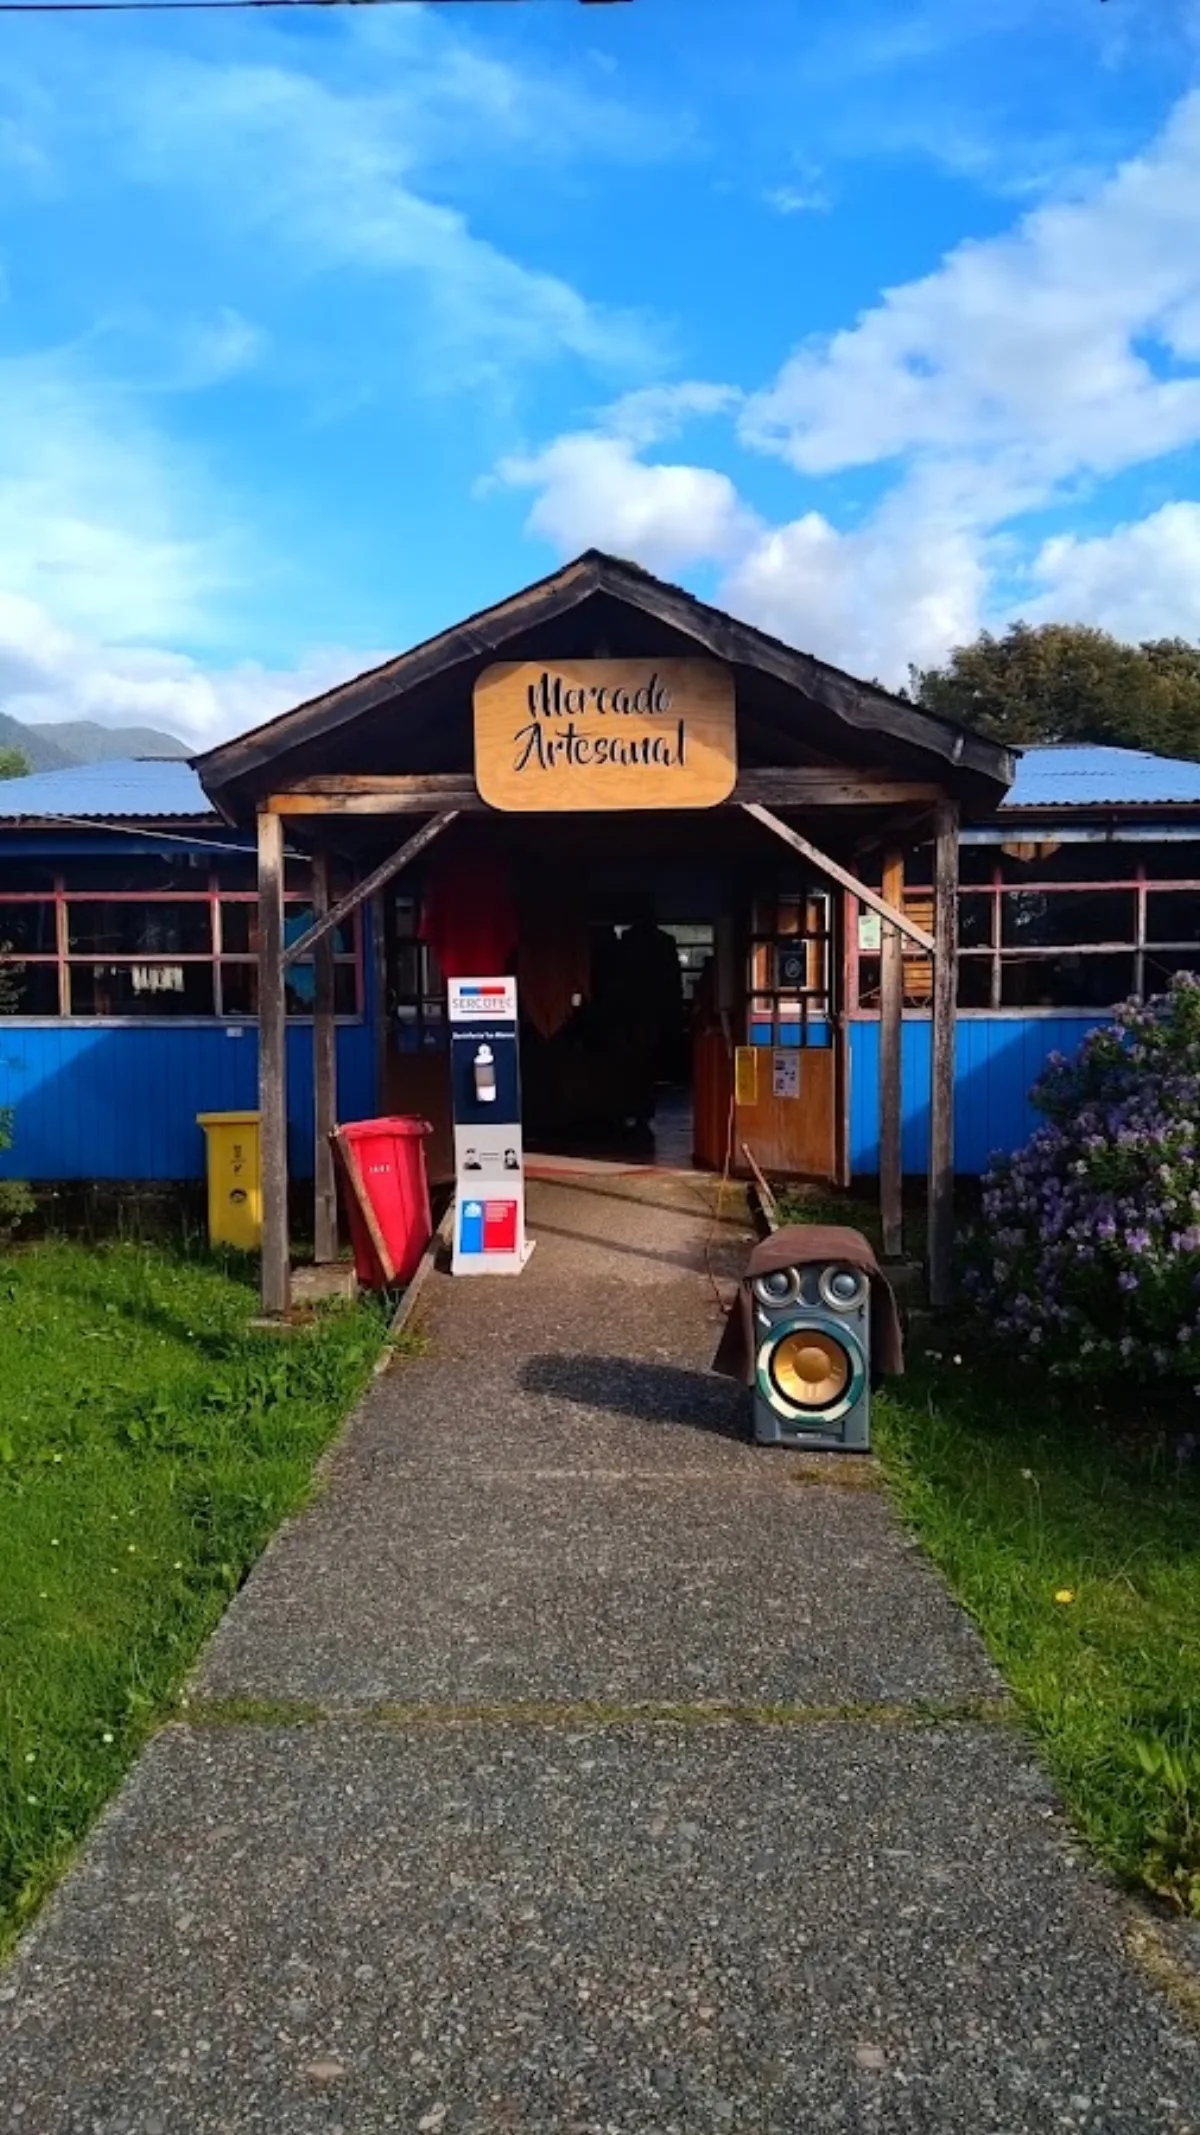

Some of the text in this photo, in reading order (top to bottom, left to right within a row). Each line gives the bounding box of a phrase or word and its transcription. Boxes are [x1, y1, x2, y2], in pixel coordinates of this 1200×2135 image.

[527, 673, 671, 718] Mercado
[514, 719, 686, 771] Artesanal
[452, 998, 513, 1009] SERCOTEC
